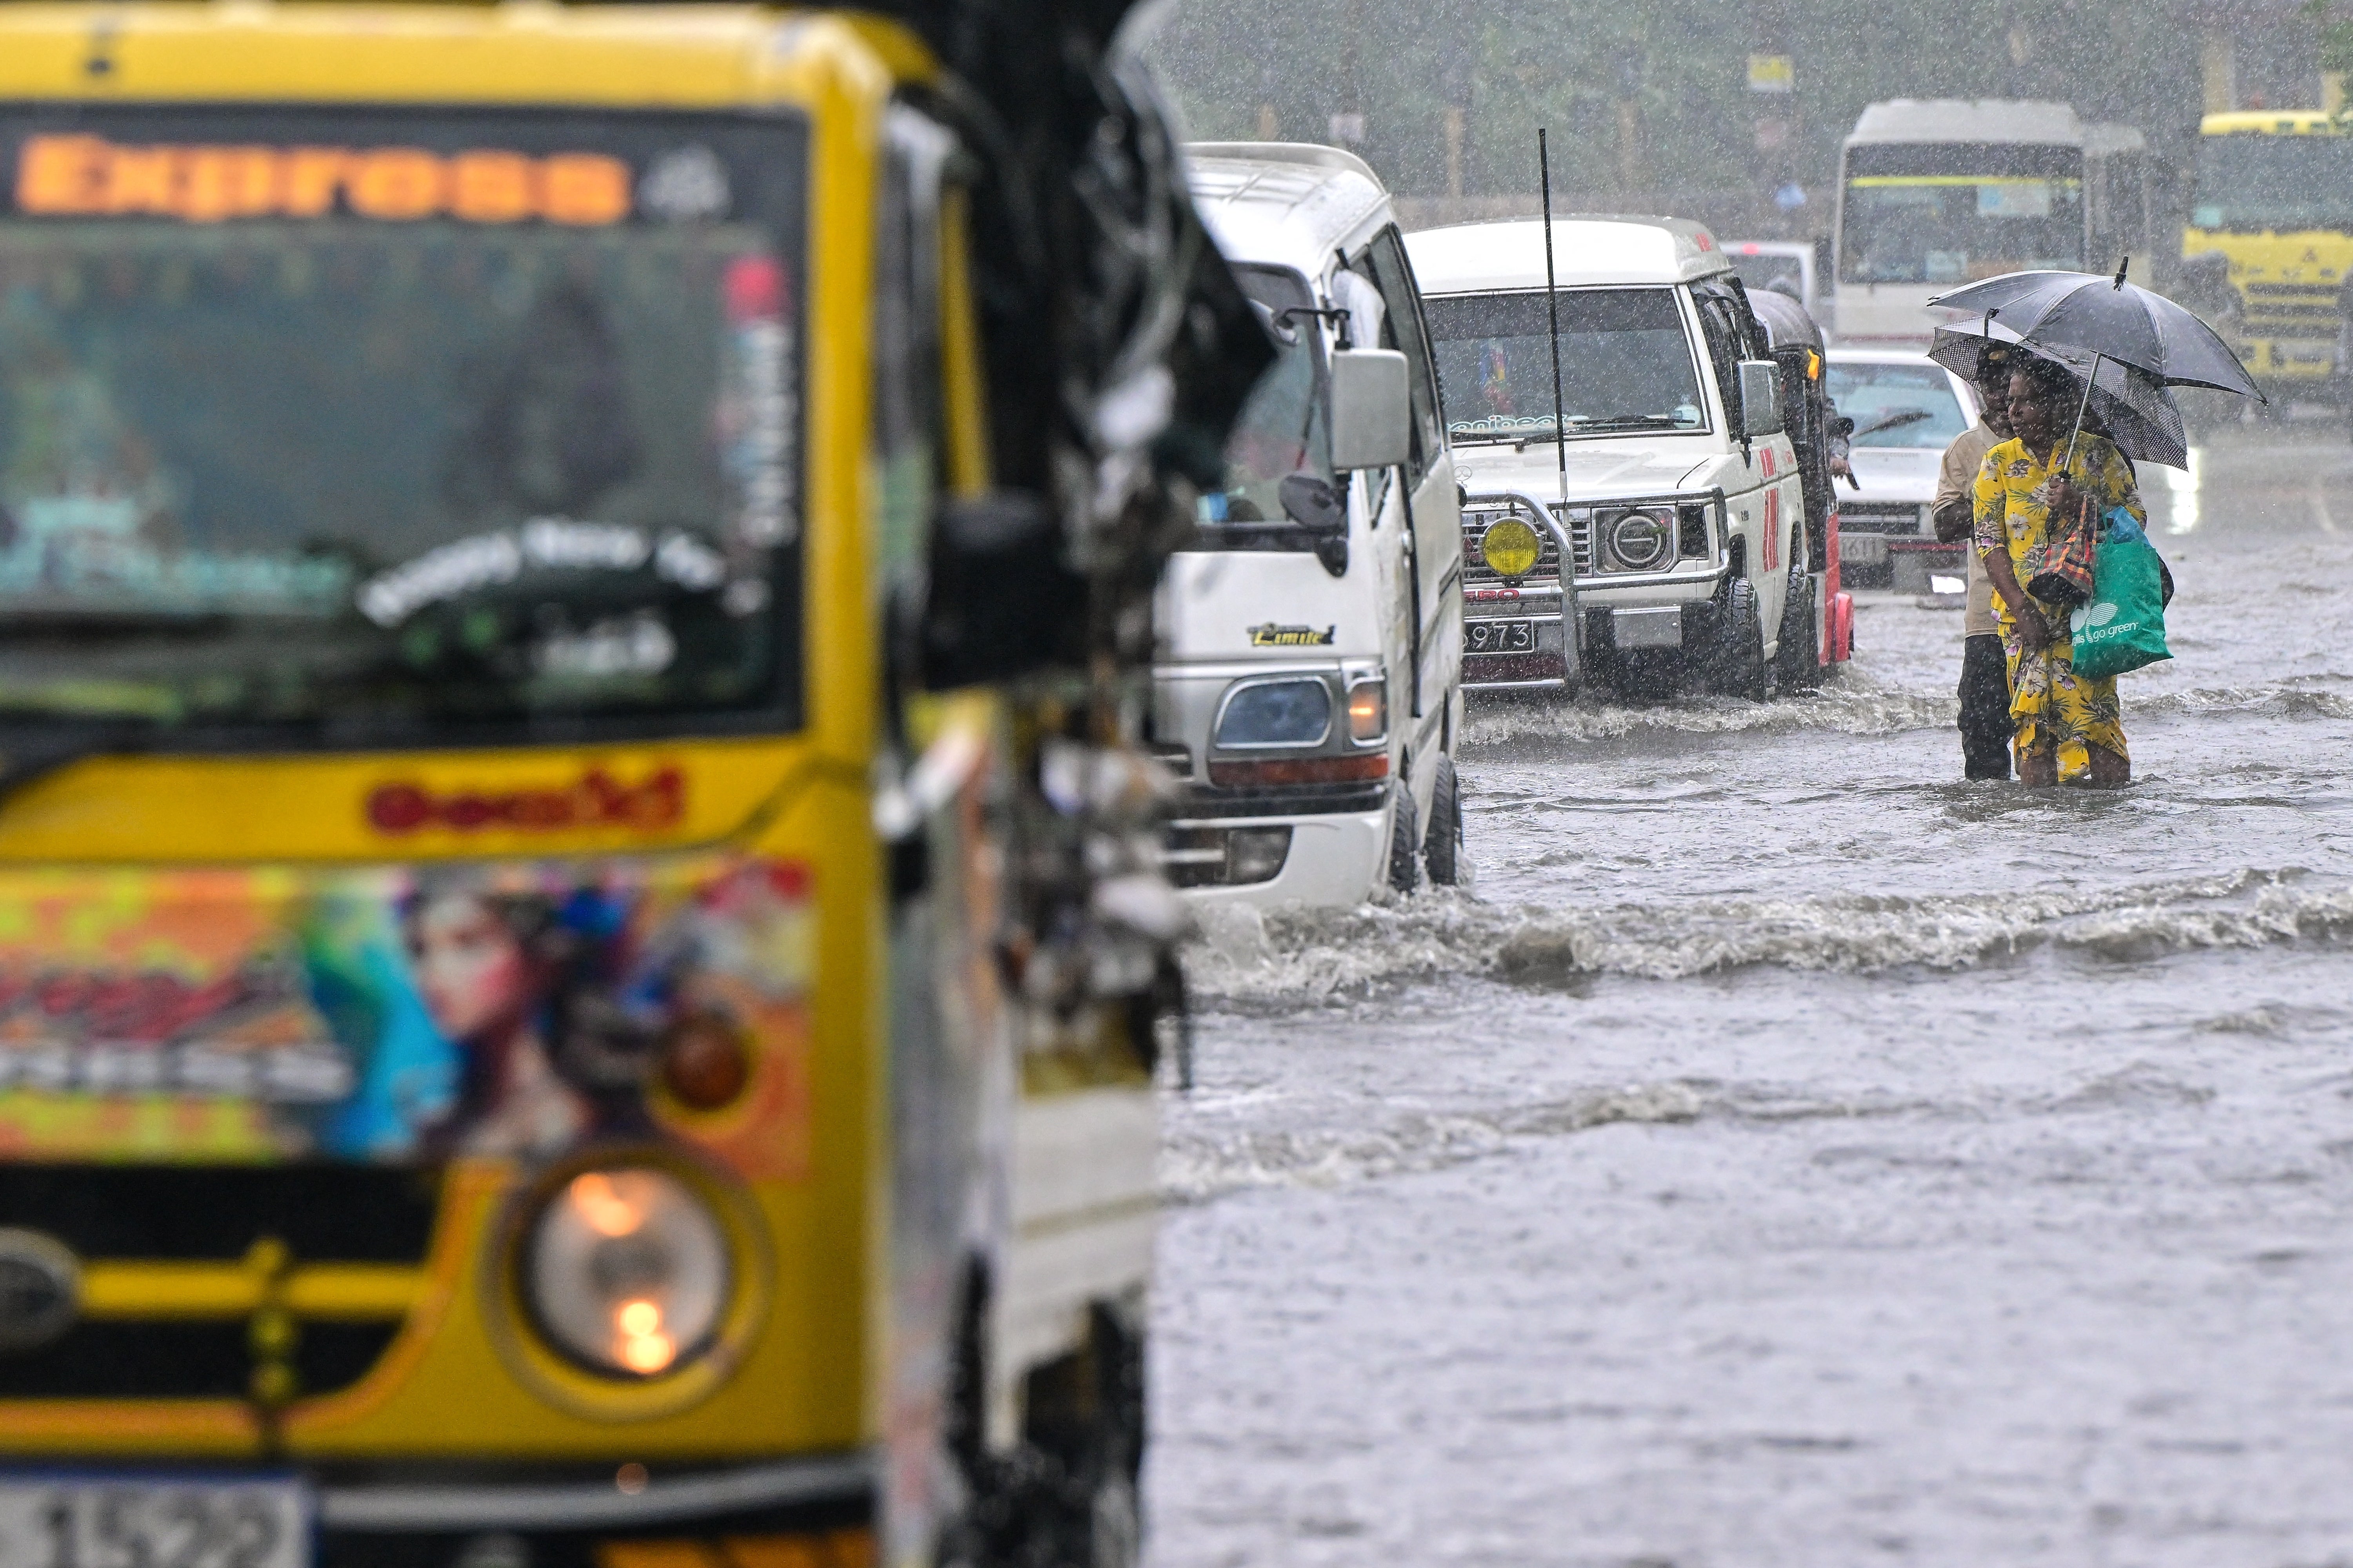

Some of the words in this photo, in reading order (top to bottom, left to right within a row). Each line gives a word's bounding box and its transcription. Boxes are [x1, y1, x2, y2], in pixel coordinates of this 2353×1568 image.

[18, 133, 631, 223] Express
[2093, 629, 2106, 642] go
[2108, 622, 2136, 638] green
